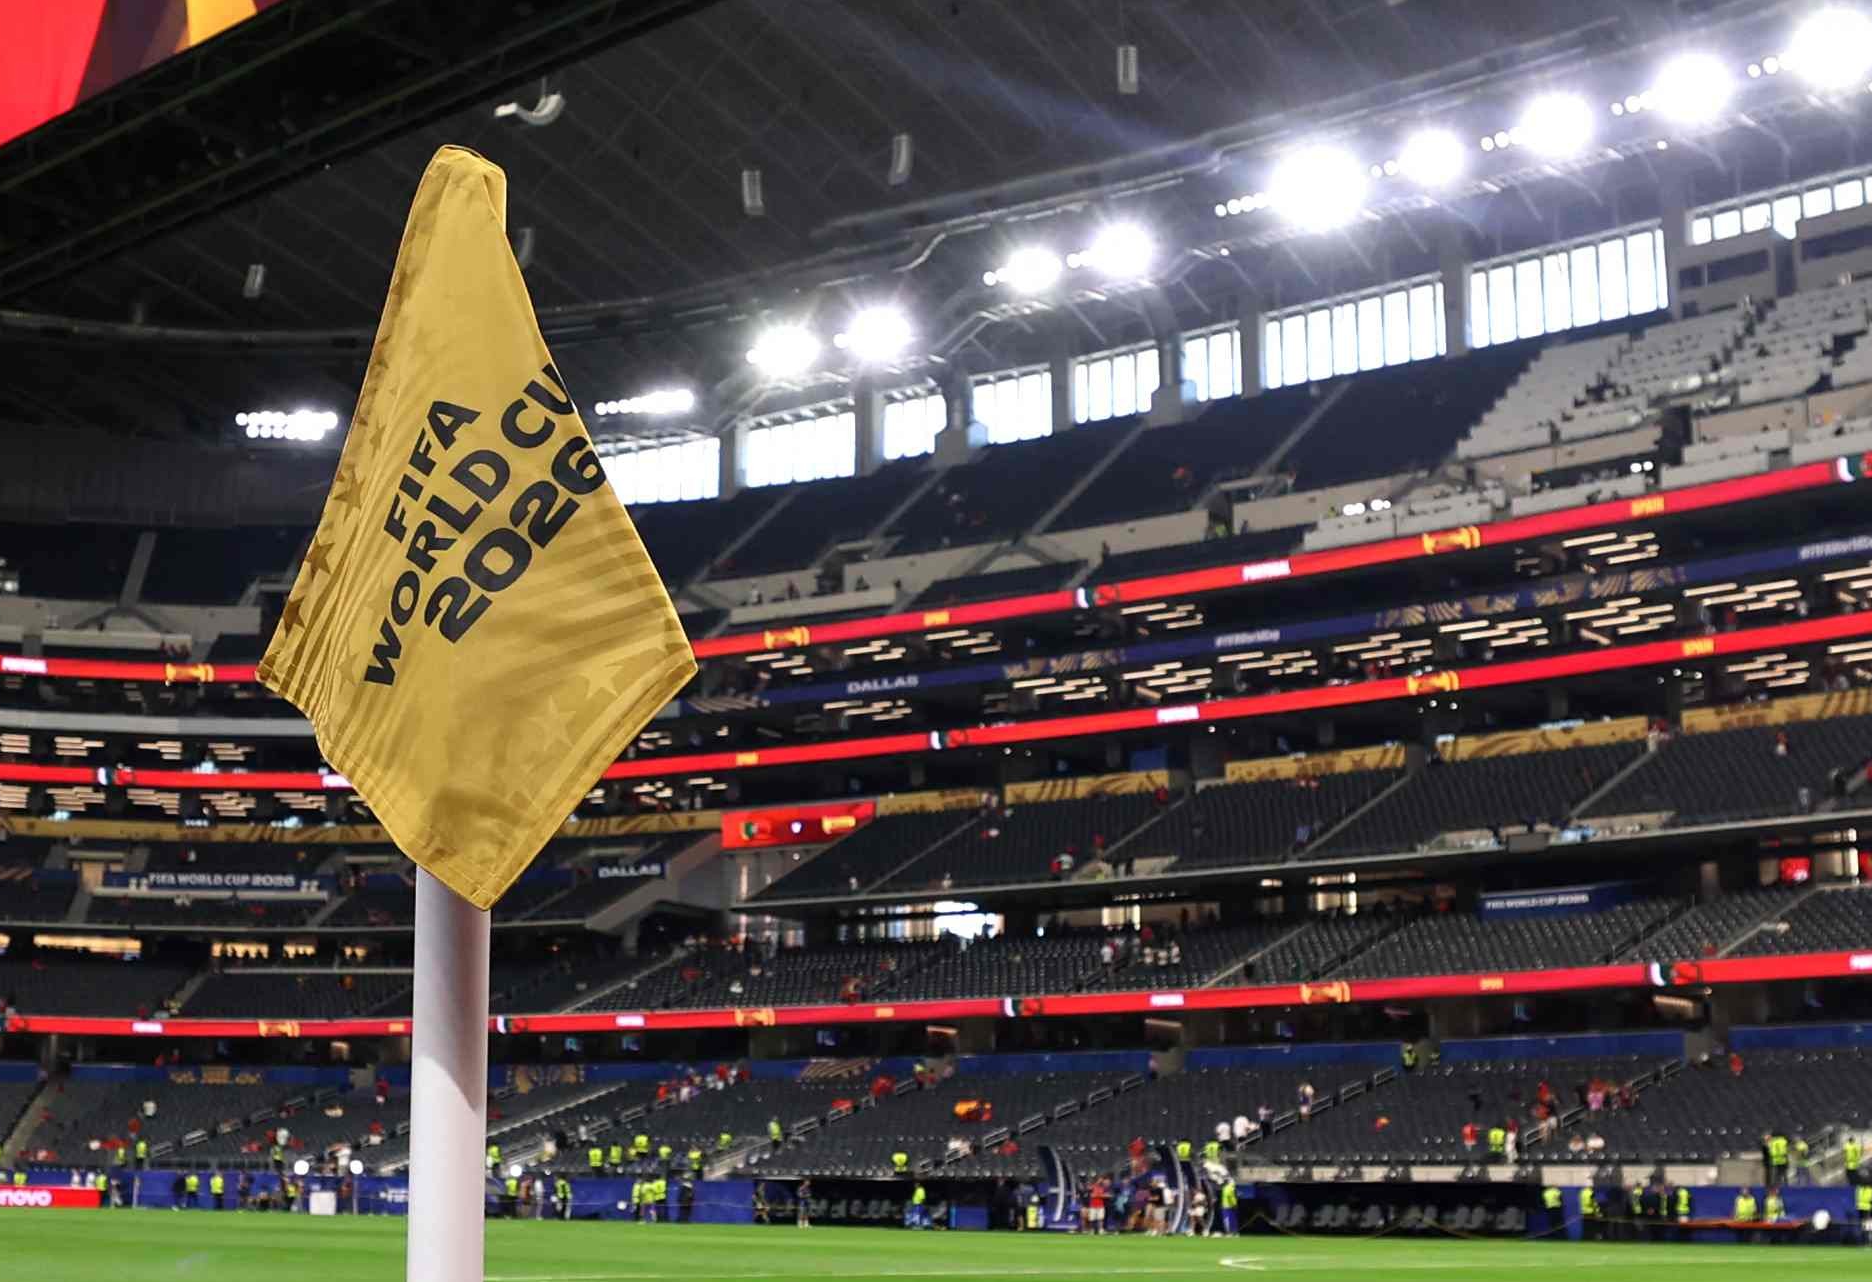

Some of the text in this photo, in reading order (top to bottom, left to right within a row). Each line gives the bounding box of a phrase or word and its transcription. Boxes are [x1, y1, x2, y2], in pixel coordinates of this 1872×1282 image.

[384, 400, 481, 543] FIFA
[364, 363, 575, 686] WORLD CU
[424, 436, 606, 644] 2026
[847, 675, 919, 694] DALLAS
[177, 874, 223, 886] WORLD
[225, 875, 249, 886] CUP
[599, 863, 661, 878] DALLAS
